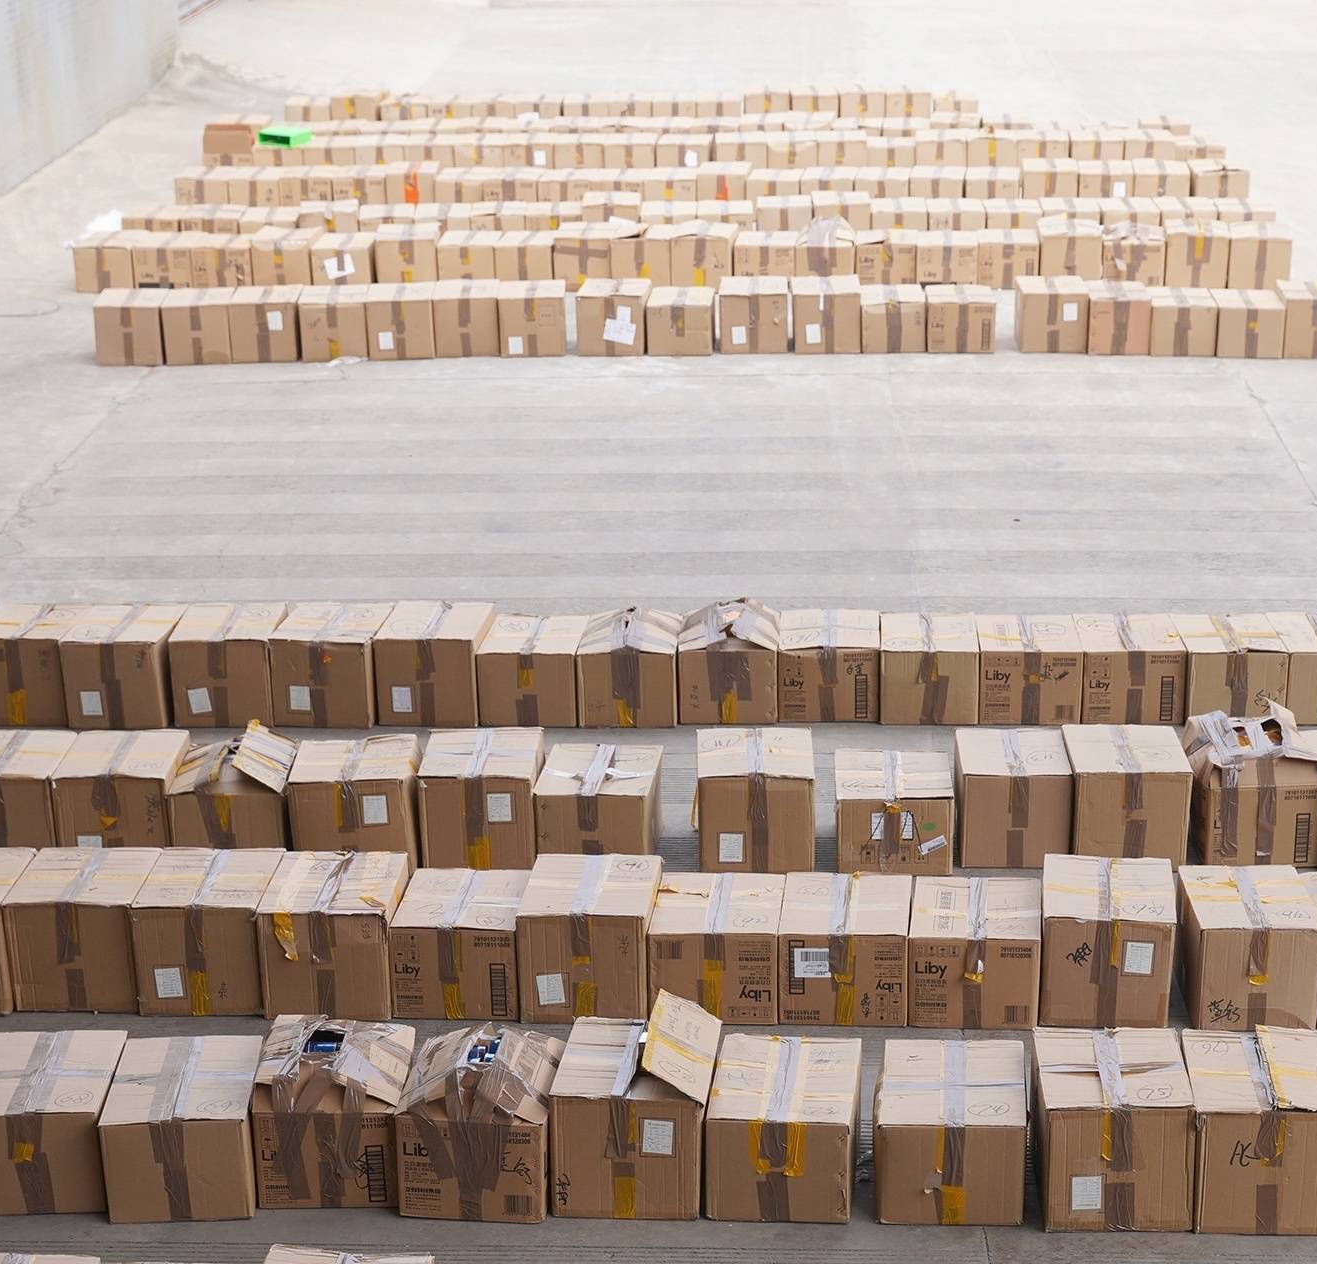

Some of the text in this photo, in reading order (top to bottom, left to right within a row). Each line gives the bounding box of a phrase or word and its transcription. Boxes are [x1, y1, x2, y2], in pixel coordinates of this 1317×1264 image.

[783, 677, 804, 690] Liby
[985, 670, 1011, 684] Liby
[1089, 679, 1110, 691] Liby
[394, 963, 420, 978] Liby
[915, 961, 947, 978] Liby
[403, 1141, 429, 1157] Lib
